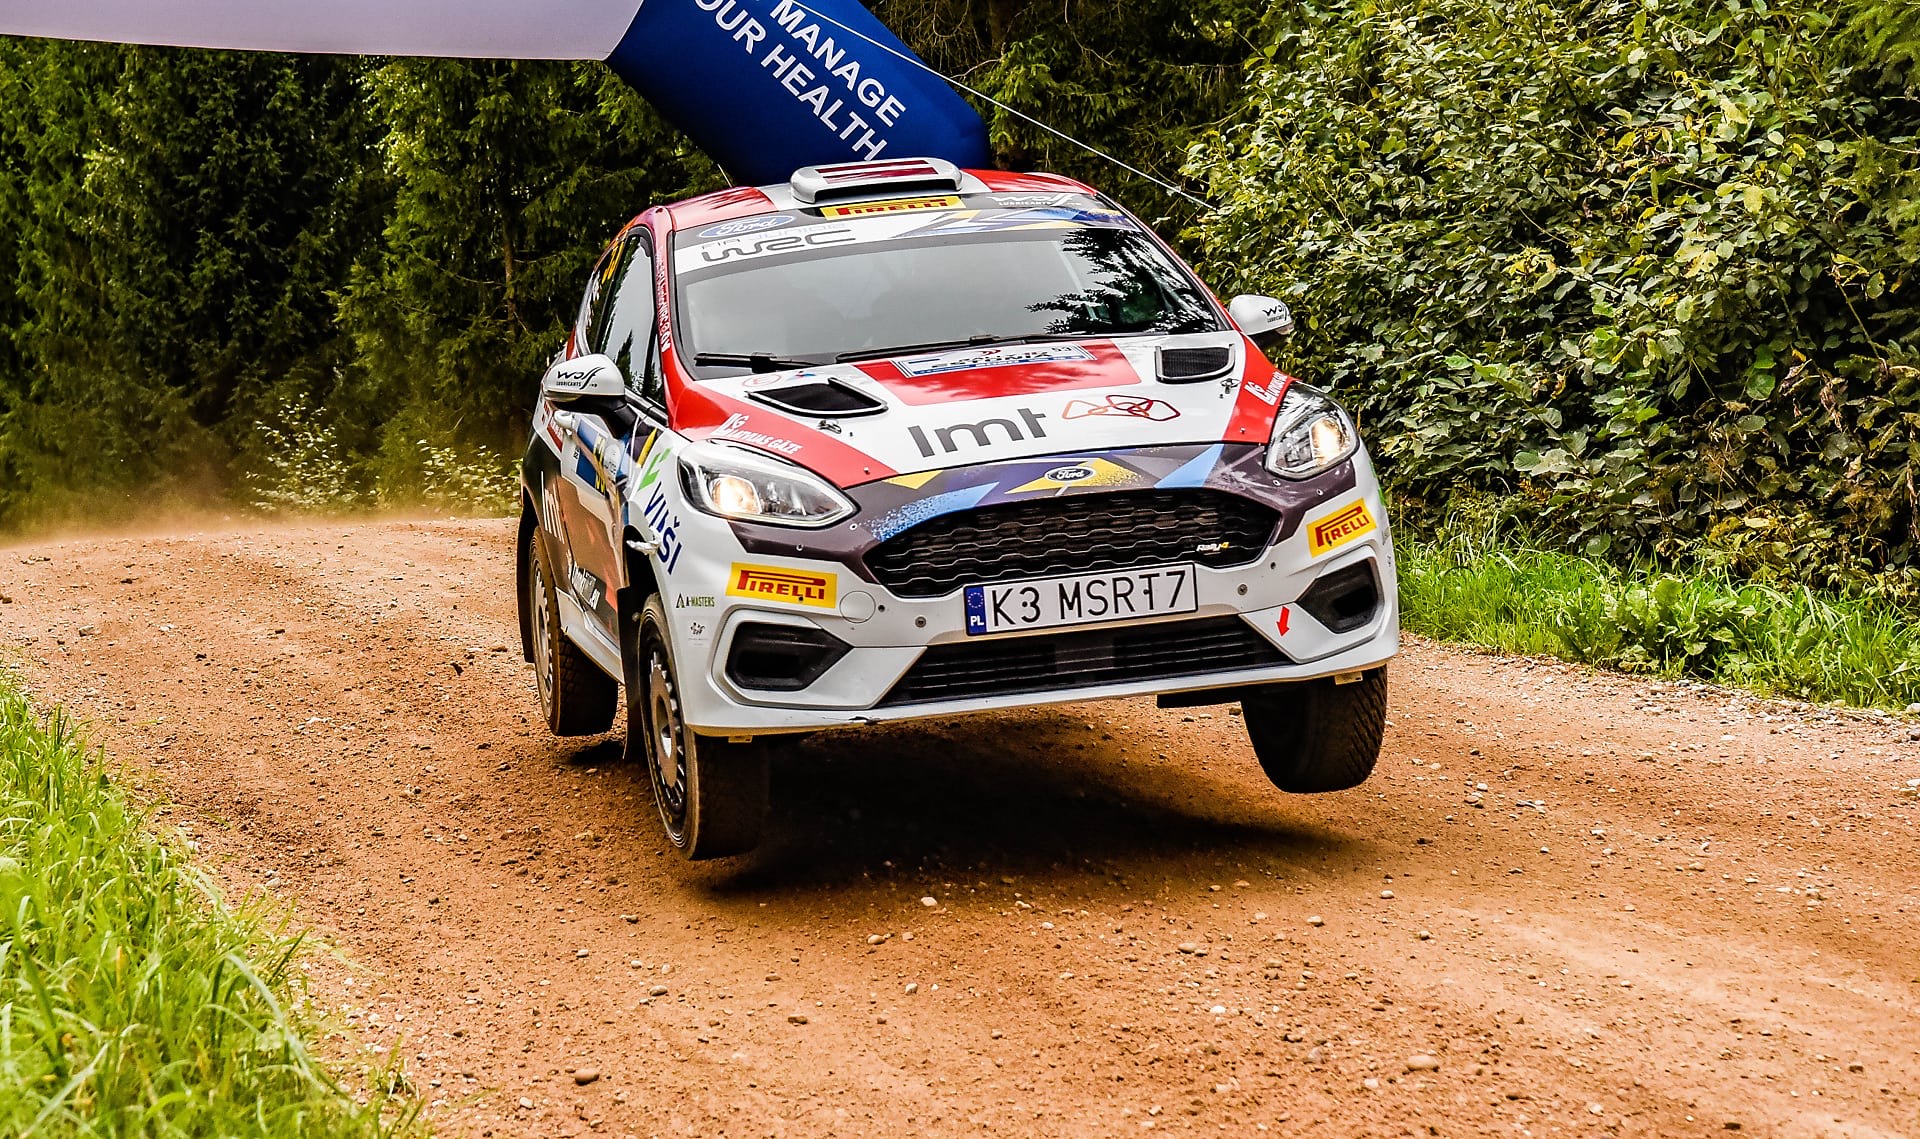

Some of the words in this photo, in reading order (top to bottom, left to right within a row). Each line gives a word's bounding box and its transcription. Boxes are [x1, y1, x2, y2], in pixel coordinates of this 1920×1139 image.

[769, 0, 906, 128] MANAGE
[760, 43, 888, 162] HEALTH
[836, 199, 948, 215] PIRELLI
[718, 218, 778, 236] Ford
[701, 229, 856, 262] WRC
[908, 407, 1047, 458] lmt
[1055, 468, 1085, 480] Ford
[1315, 506, 1370, 547] PIRELLI
[737, 569, 826, 600] PIRELLI
[991, 586, 1041, 627] K3
[1058, 569, 1187, 620] MSRT7
[970, 616, 985, 626] PL
